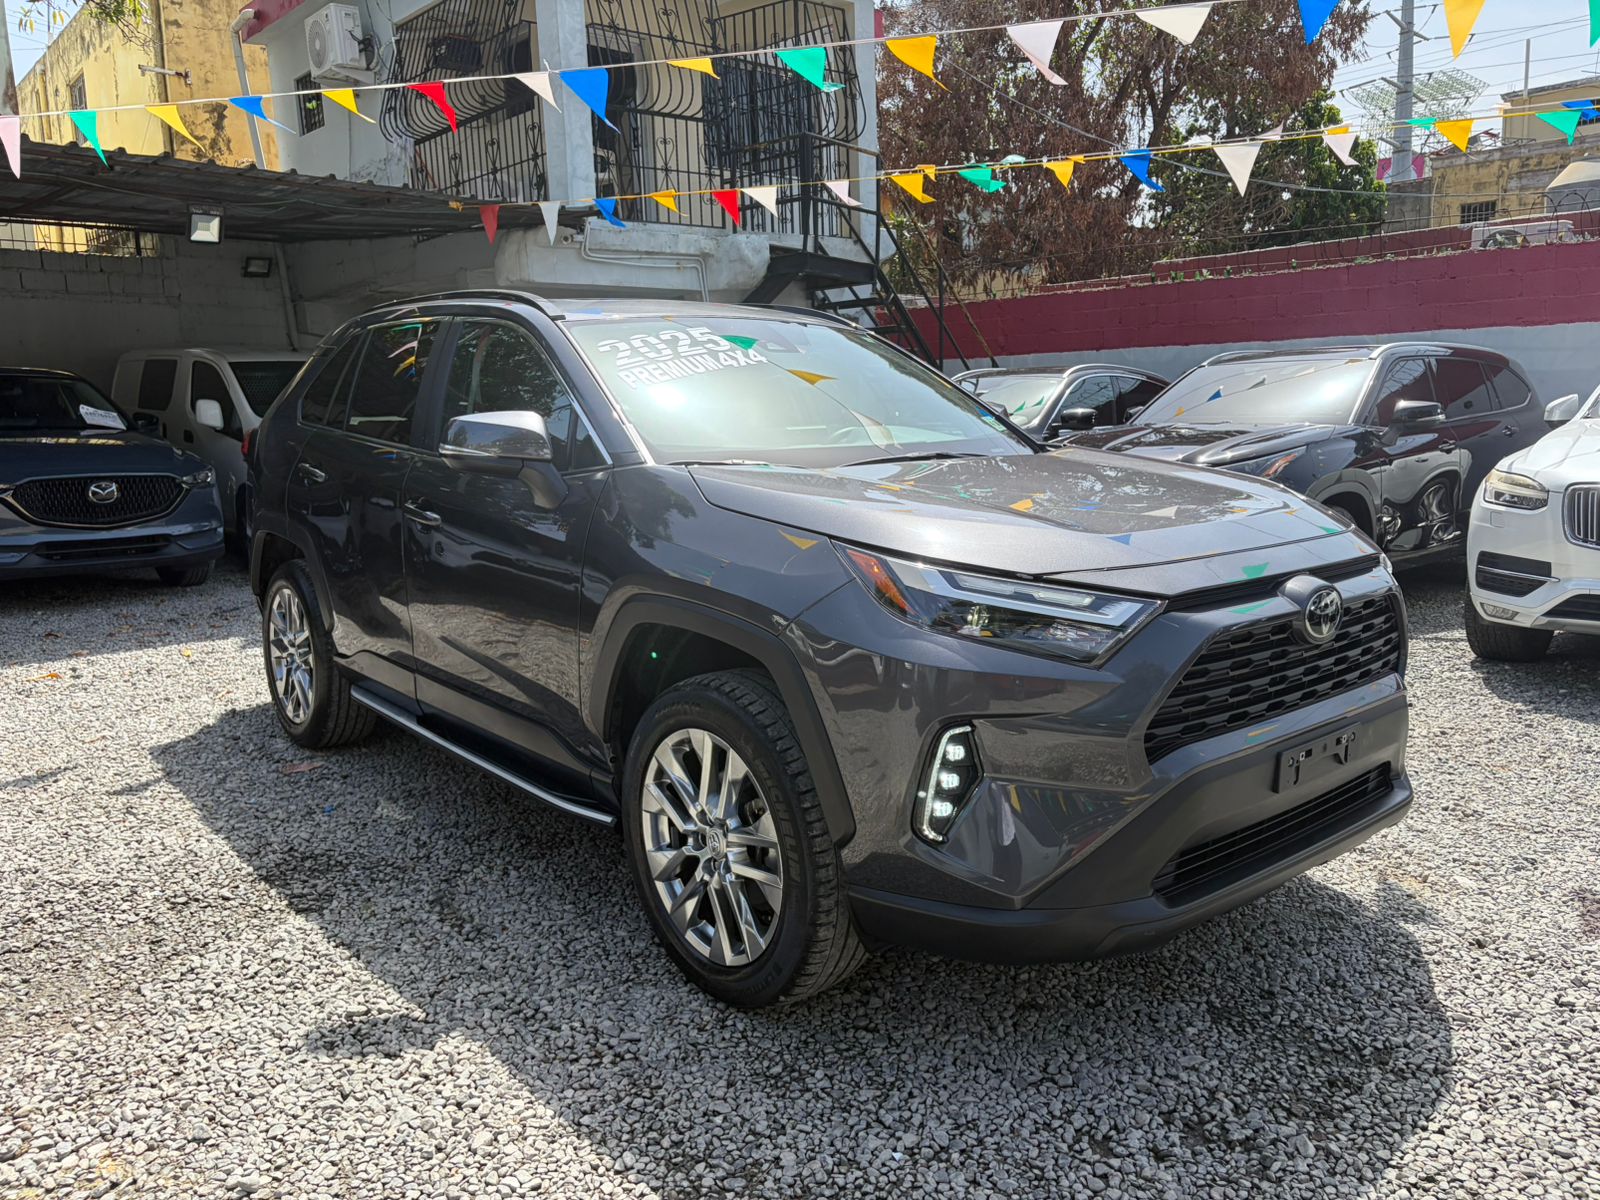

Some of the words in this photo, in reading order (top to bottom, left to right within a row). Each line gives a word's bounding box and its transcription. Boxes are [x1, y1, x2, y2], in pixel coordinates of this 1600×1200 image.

[597, 327, 730, 371] 2025
[617, 354, 724, 390] PREMIUM
[718, 349, 768, 368] 4X4
